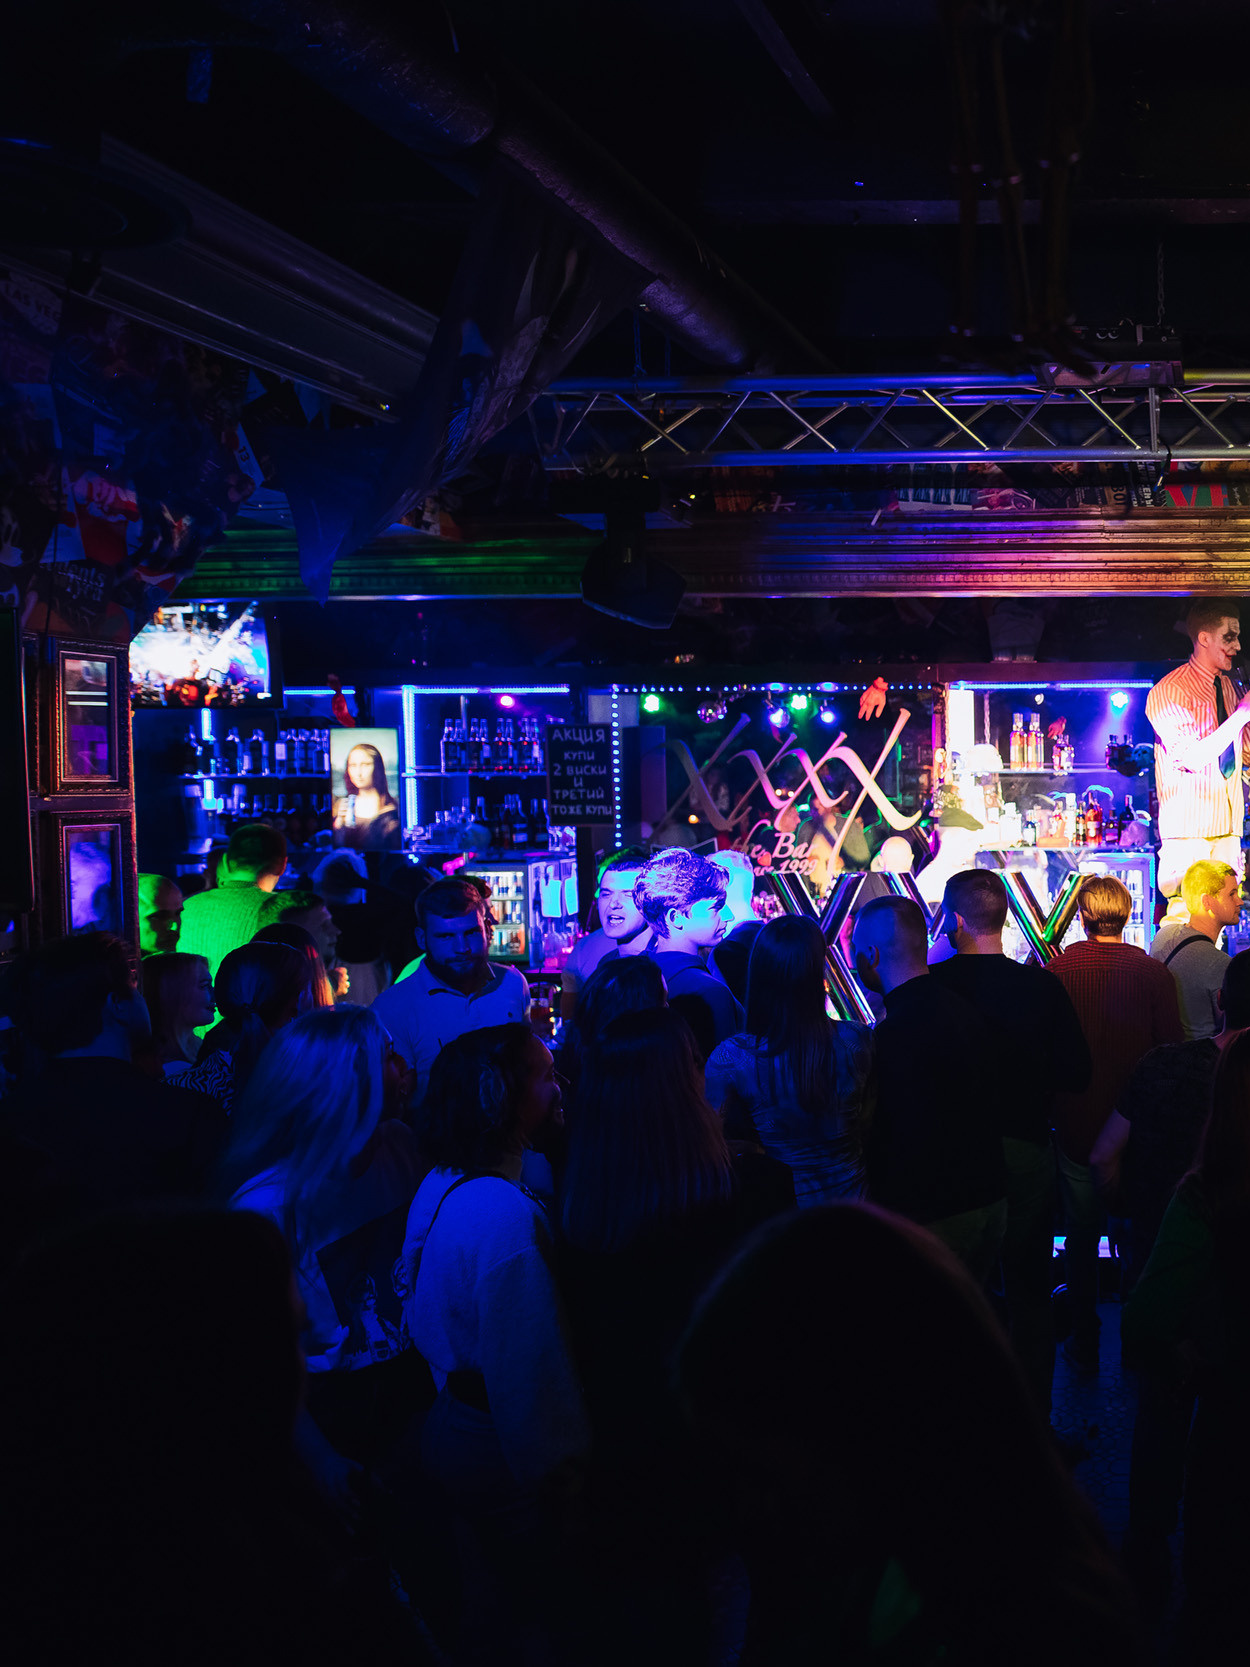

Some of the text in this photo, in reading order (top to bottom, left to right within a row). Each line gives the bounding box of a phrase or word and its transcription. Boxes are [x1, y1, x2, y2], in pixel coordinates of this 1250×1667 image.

[552, 728, 606, 745] АКЦИЯ
[563, 750, 595, 761] КУПИ
[553, 763, 607, 776] 2 ВИСКИ
[573, 776, 584, 787] И
[553, 786, 605, 800] ТРЕТИЙ
[551, 804, 612, 815] ТОЖЕ КУПИ
[779, 858, 819, 876] 1999
